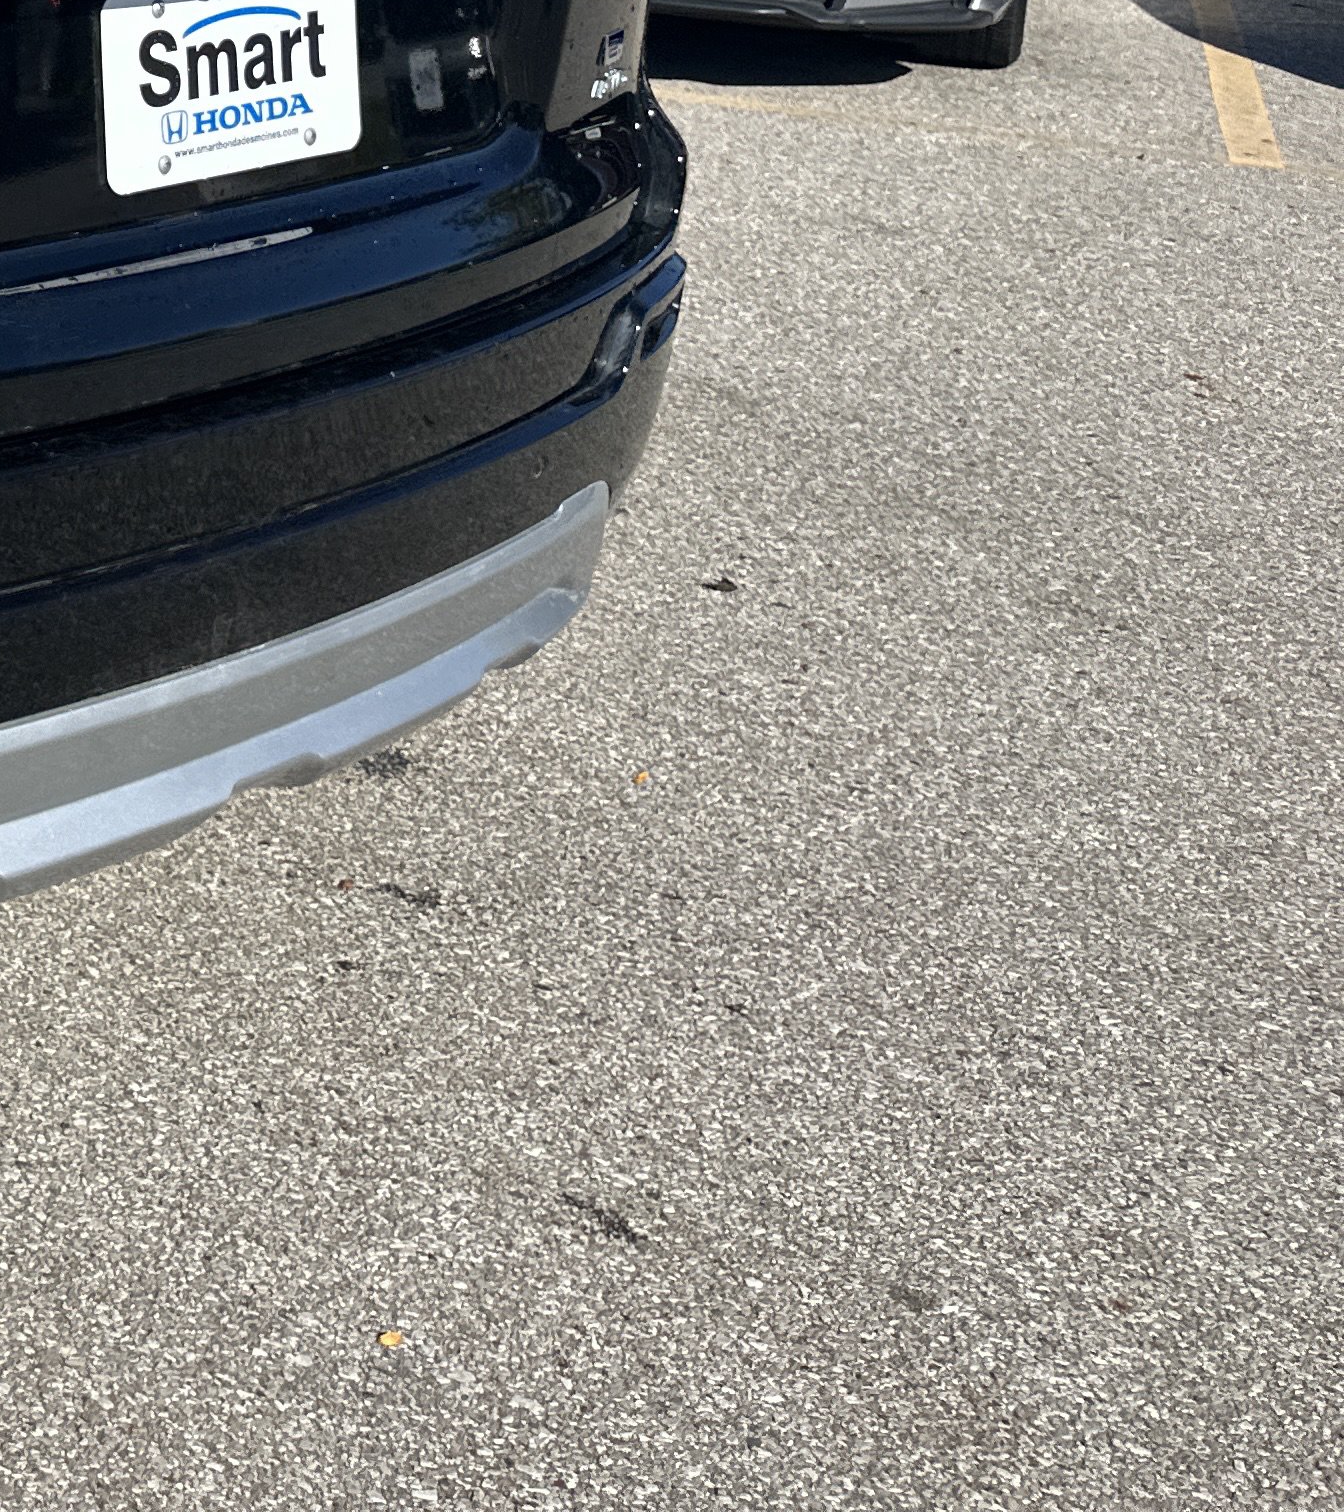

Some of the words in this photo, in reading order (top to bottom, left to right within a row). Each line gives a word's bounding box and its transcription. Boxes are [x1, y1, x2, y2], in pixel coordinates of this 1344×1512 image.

[138, 9, 327, 108] Smart
[192, 92, 314, 136] HONDA
[174, 126, 300, 159] www.smarthondadesmoines.com
